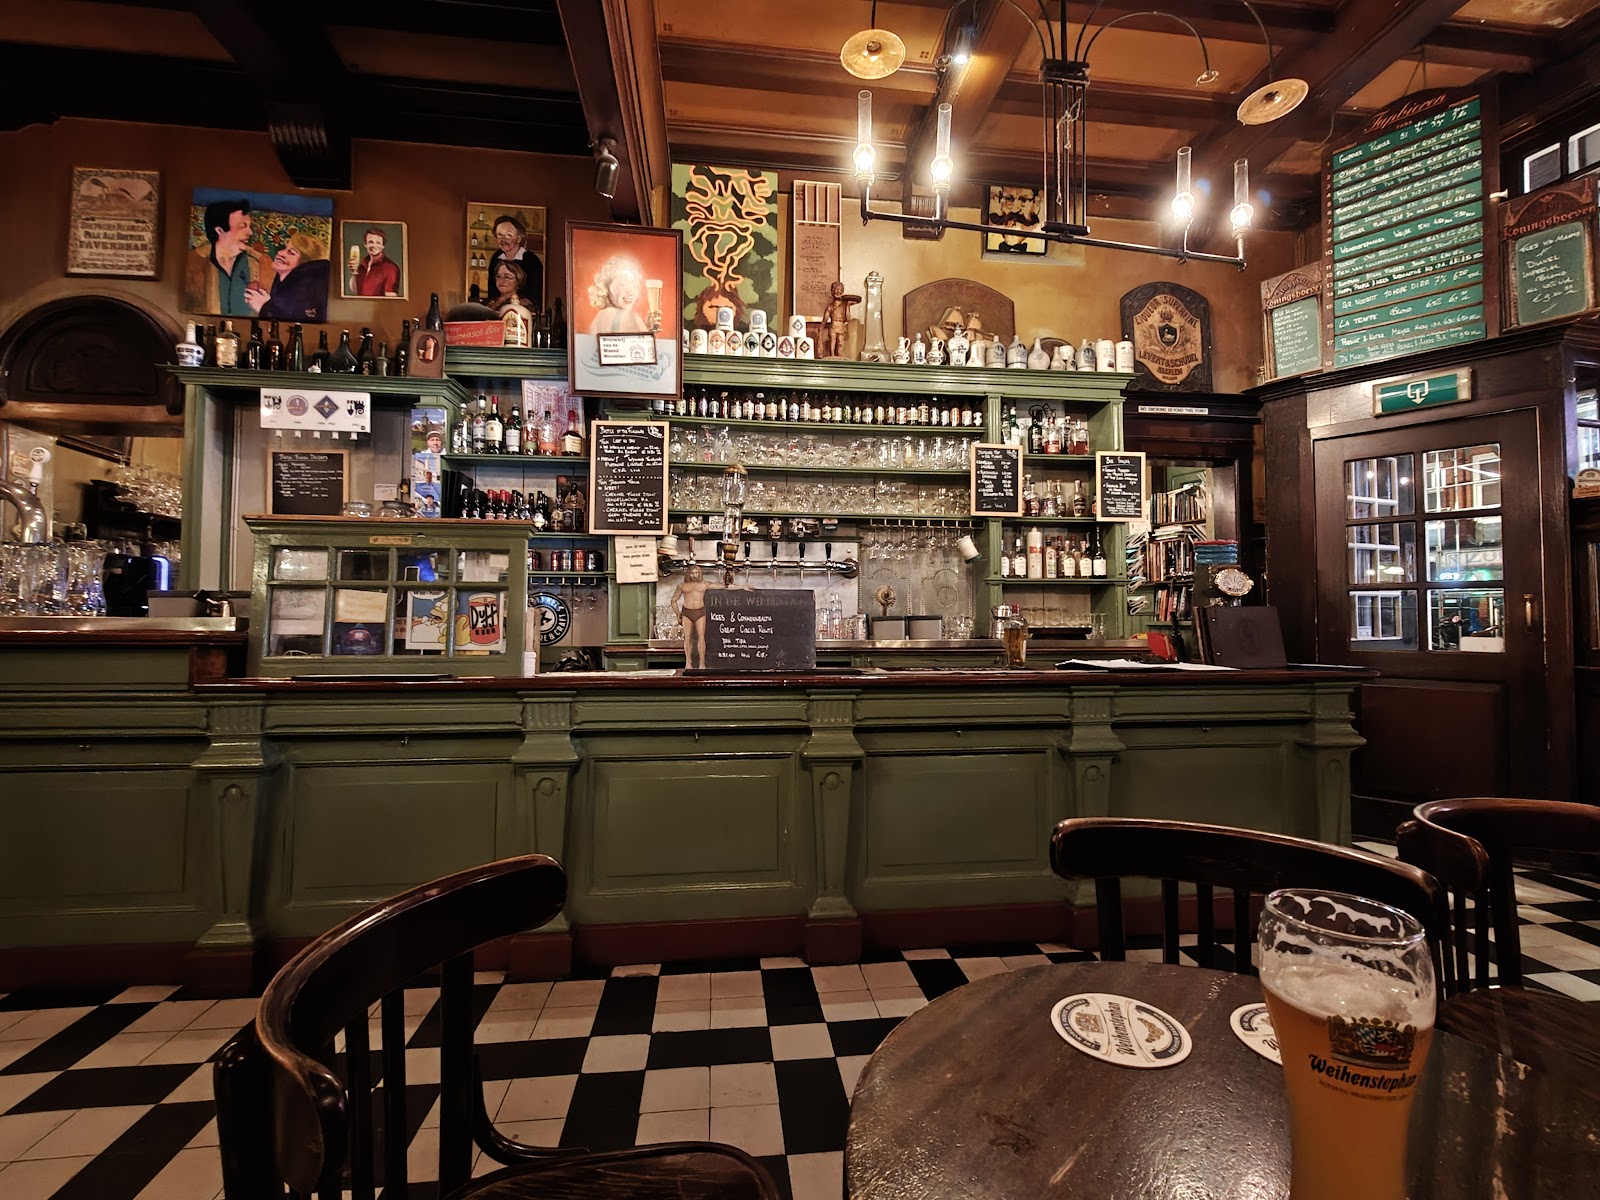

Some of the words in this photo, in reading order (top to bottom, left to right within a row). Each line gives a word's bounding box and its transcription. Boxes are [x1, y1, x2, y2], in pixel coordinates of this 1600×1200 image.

[1364, 95, 1446, 133] Tapbieren
[470, 603, 498, 630] Duff
[554, 613, 567, 636] CRAFT
[1105, 1001, 1137, 1056] Weihenstephan
